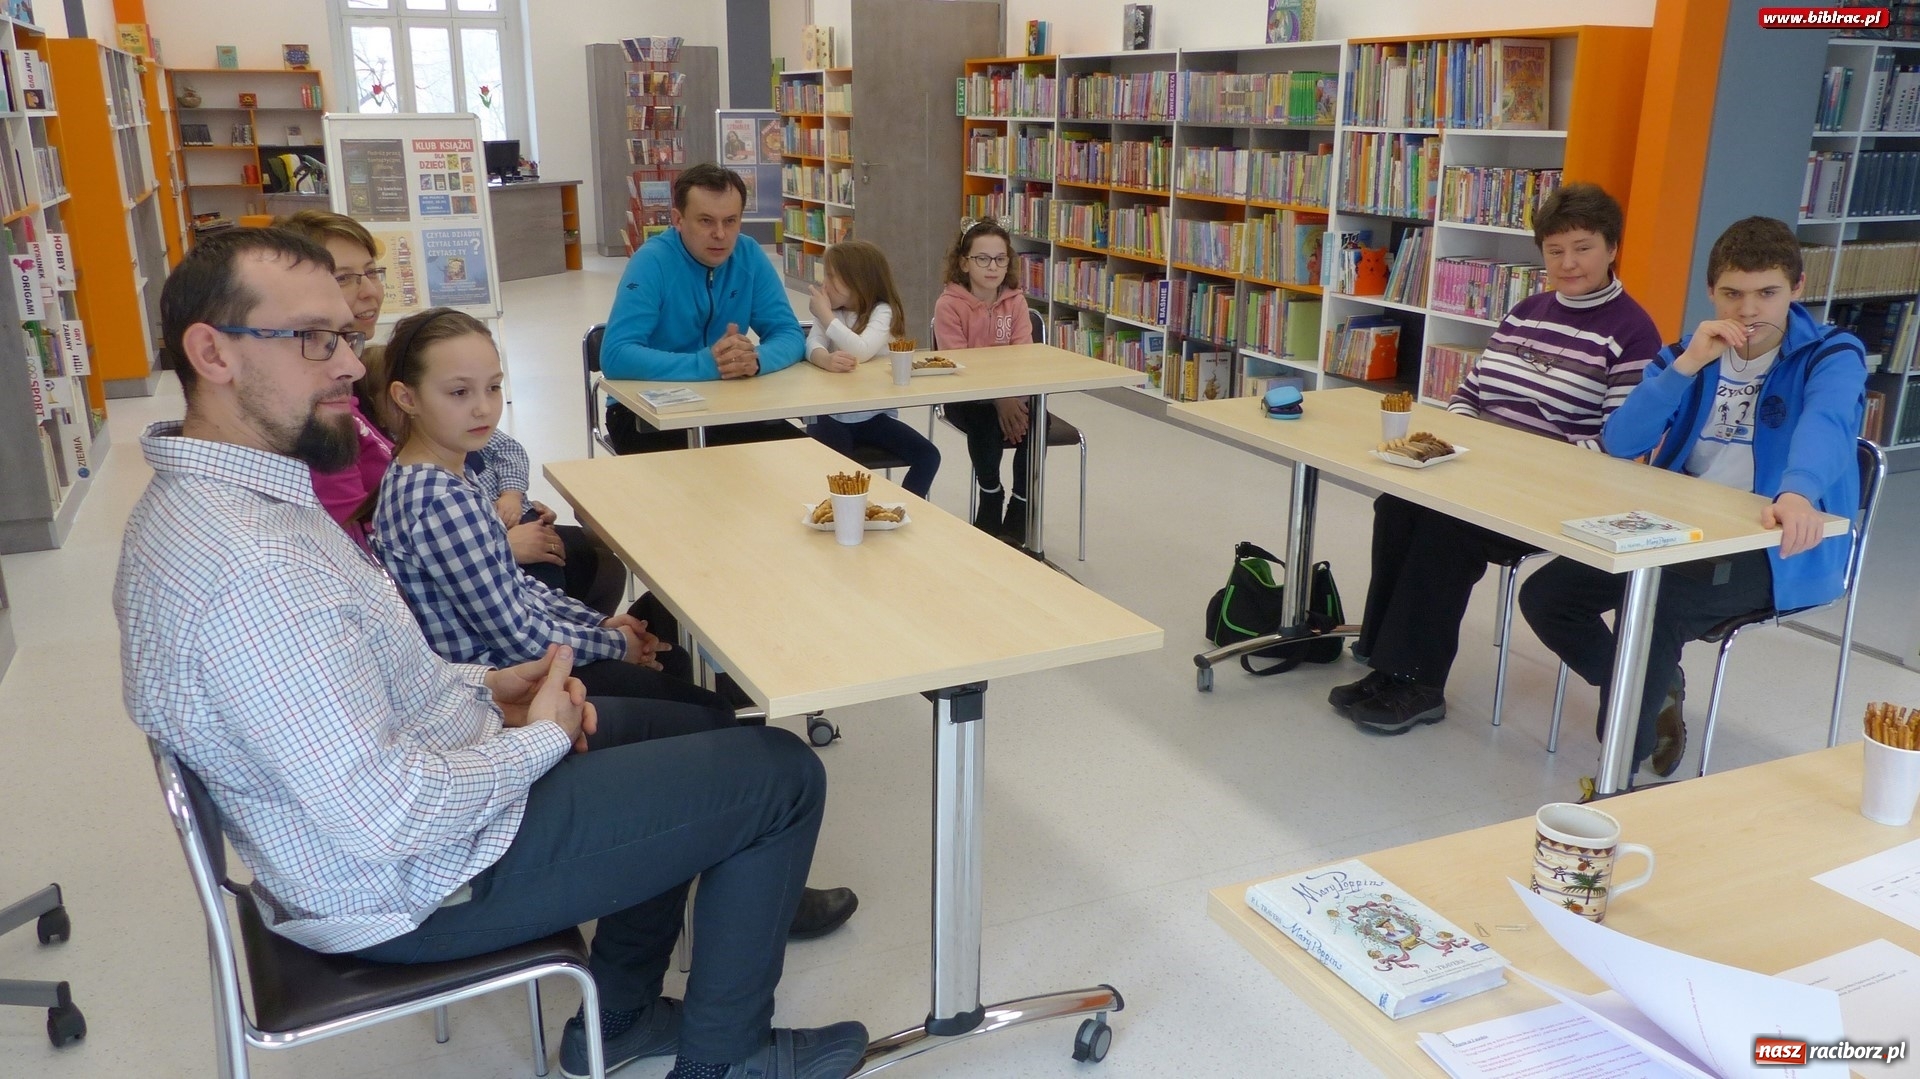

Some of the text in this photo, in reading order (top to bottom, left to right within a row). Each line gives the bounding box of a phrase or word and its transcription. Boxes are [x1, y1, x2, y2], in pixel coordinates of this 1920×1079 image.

[24, 52, 33, 73] FILMY
[416, 140, 471, 152] KLUB KSIĄŻKI
[420, 160, 446, 169] DZIECI
[33, 244, 45, 279] RYSUNEK
[53, 235, 66, 271] HOBBY
[22, 275, 35, 315] ORIGAMI
[62, 324, 73, 351] ZABAWY
[30, 380, 45, 417] SPORT
[76, 436, 87, 467] ZIEMIA
[1292, 870, 1385, 915] Mary Poppins
[1282, 922, 1312, 952] Mary
[1306, 930, 1342, 970] Poppins
